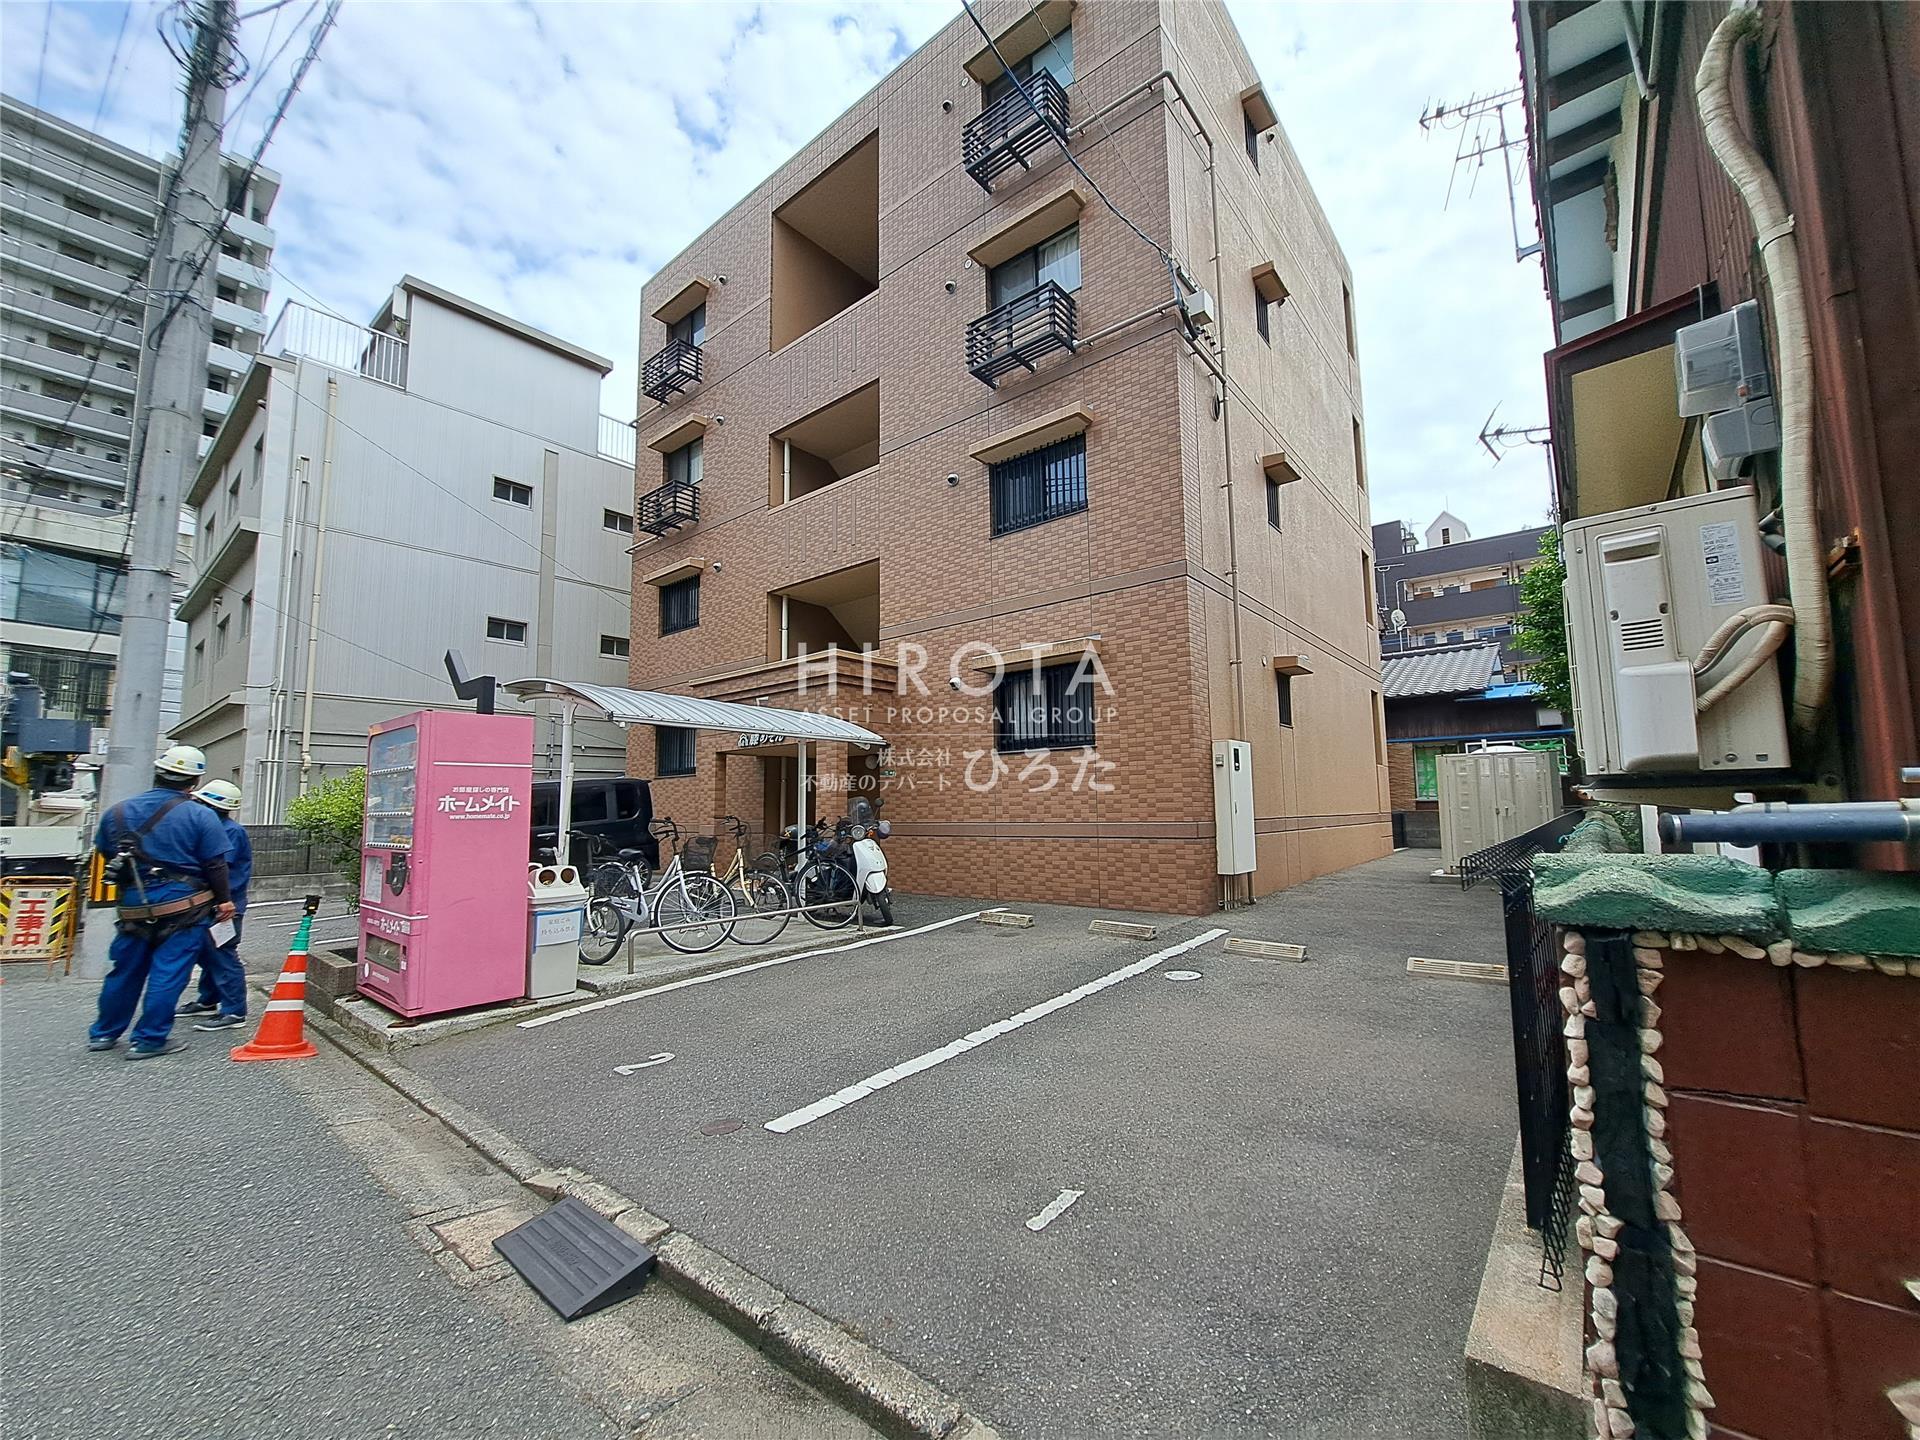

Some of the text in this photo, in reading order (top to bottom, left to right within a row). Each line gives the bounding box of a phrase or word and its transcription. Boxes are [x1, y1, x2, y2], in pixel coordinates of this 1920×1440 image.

[437, 795, 520, 812] ホームメイト
[11, 899, 48, 947] 工事中
